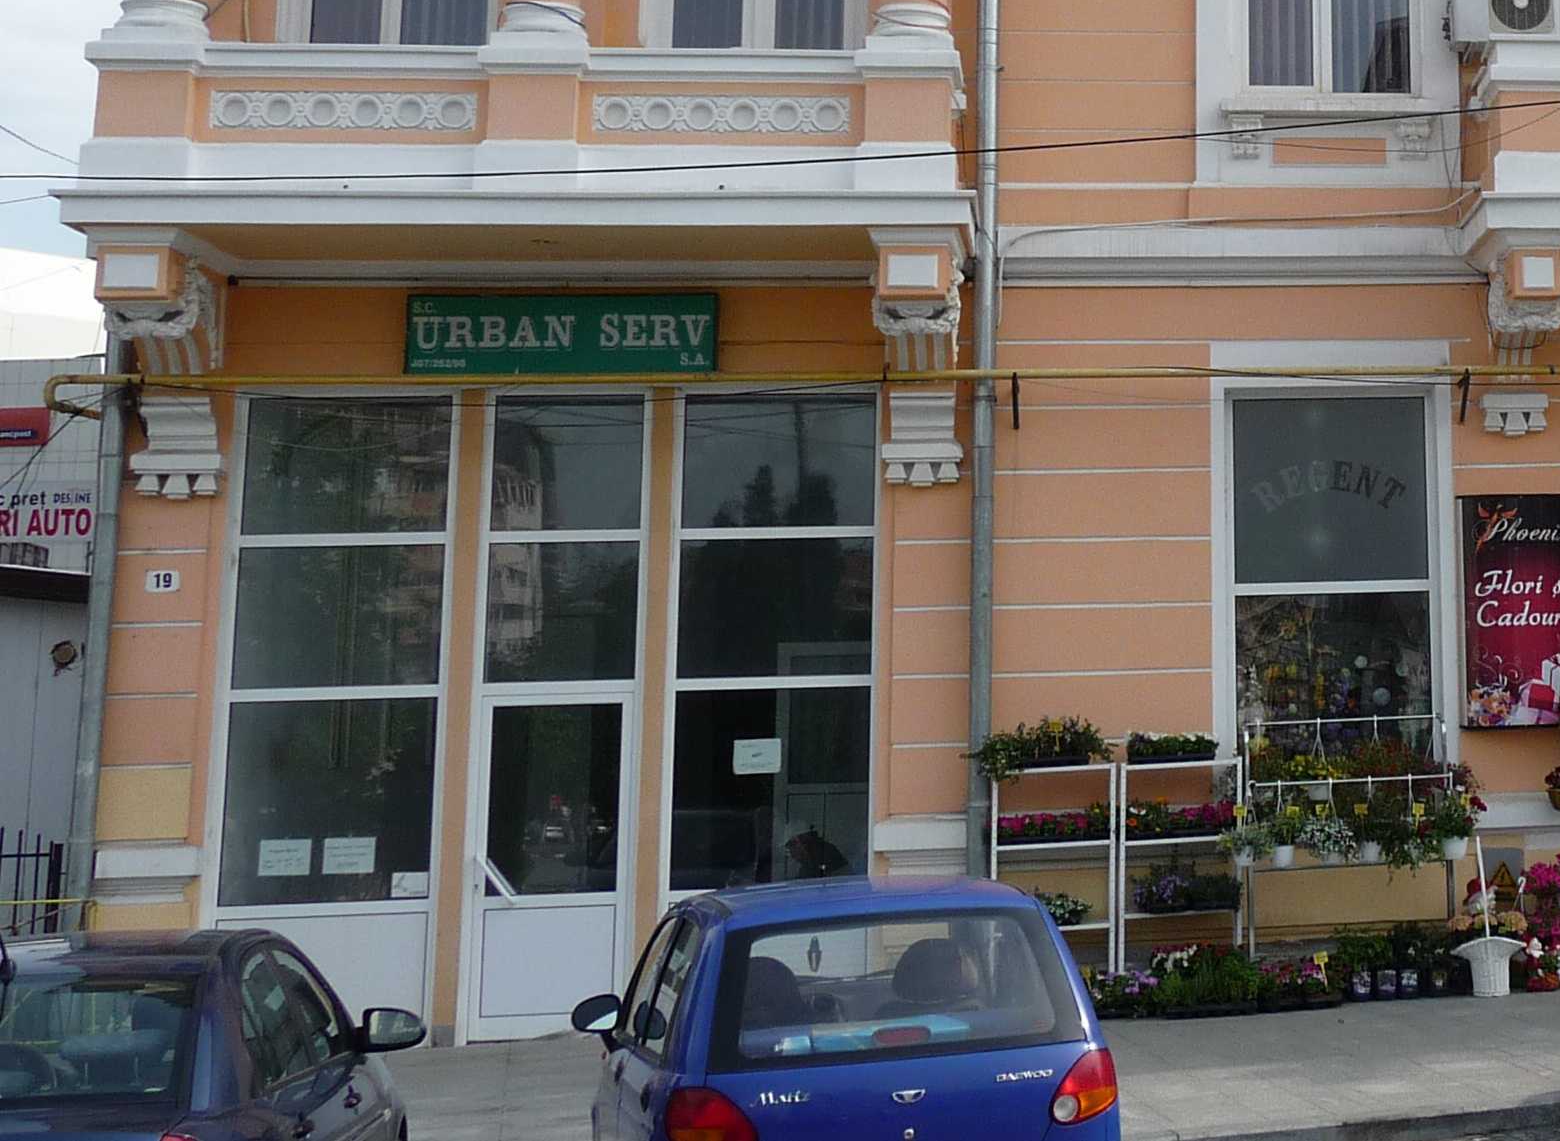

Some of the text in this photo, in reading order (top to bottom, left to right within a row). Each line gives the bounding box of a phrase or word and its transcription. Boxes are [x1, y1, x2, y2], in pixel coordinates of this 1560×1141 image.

[412, 300, 438, 314] S.C.
[413, 313, 710, 350] URBAN SERV
[680, 352, 708, 366] S.A.
[1250, 460, 1407, 513] REGENT
[26, 508, 92, 536] AUTO
[153, 572, 173, 589] 19
[1475, 569, 1544, 597] Flori
[996, 1068, 1054, 1083] DAEWOO
